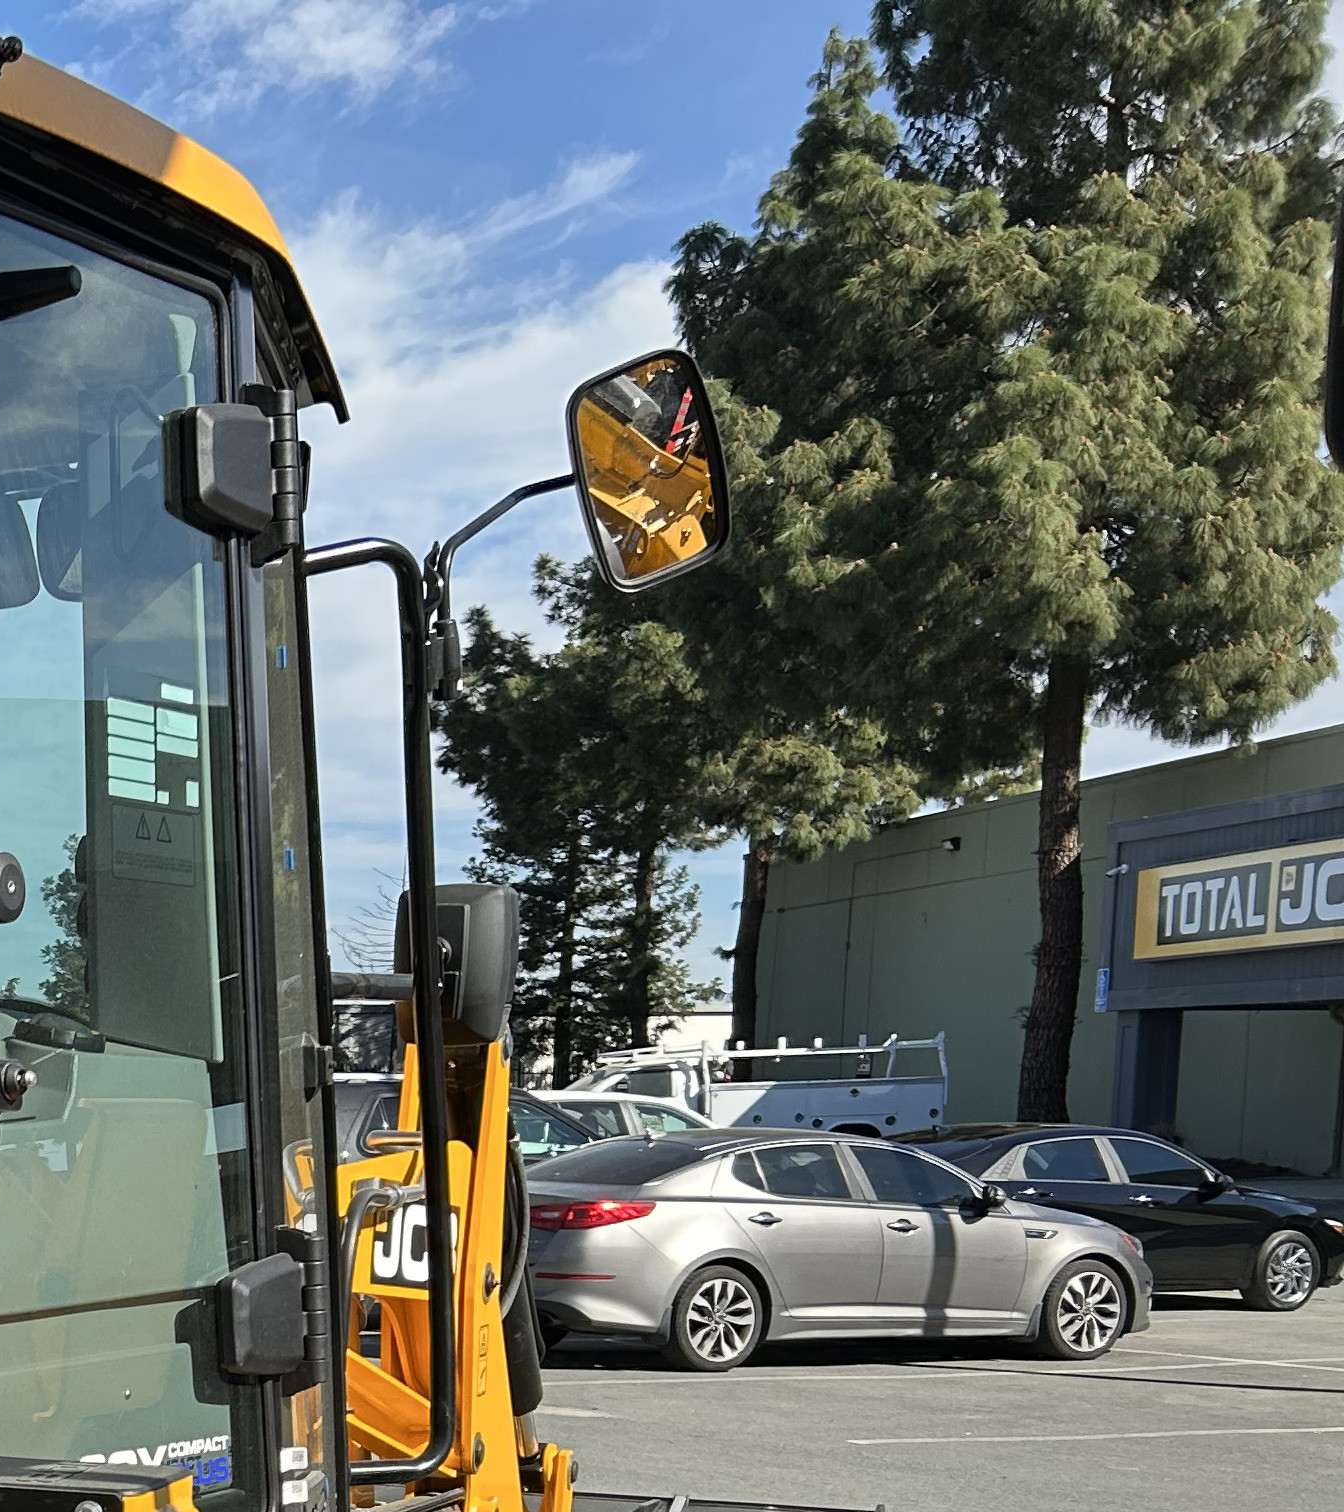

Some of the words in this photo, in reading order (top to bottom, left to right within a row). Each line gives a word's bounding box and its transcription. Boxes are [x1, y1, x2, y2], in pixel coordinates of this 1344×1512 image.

[1162, 872, 1265, 937] TOTAL
[1279, 858, 1344, 925] JC
[373, 1203, 459, 1283] JC
[167, 1434, 231, 1459] COMPACT
